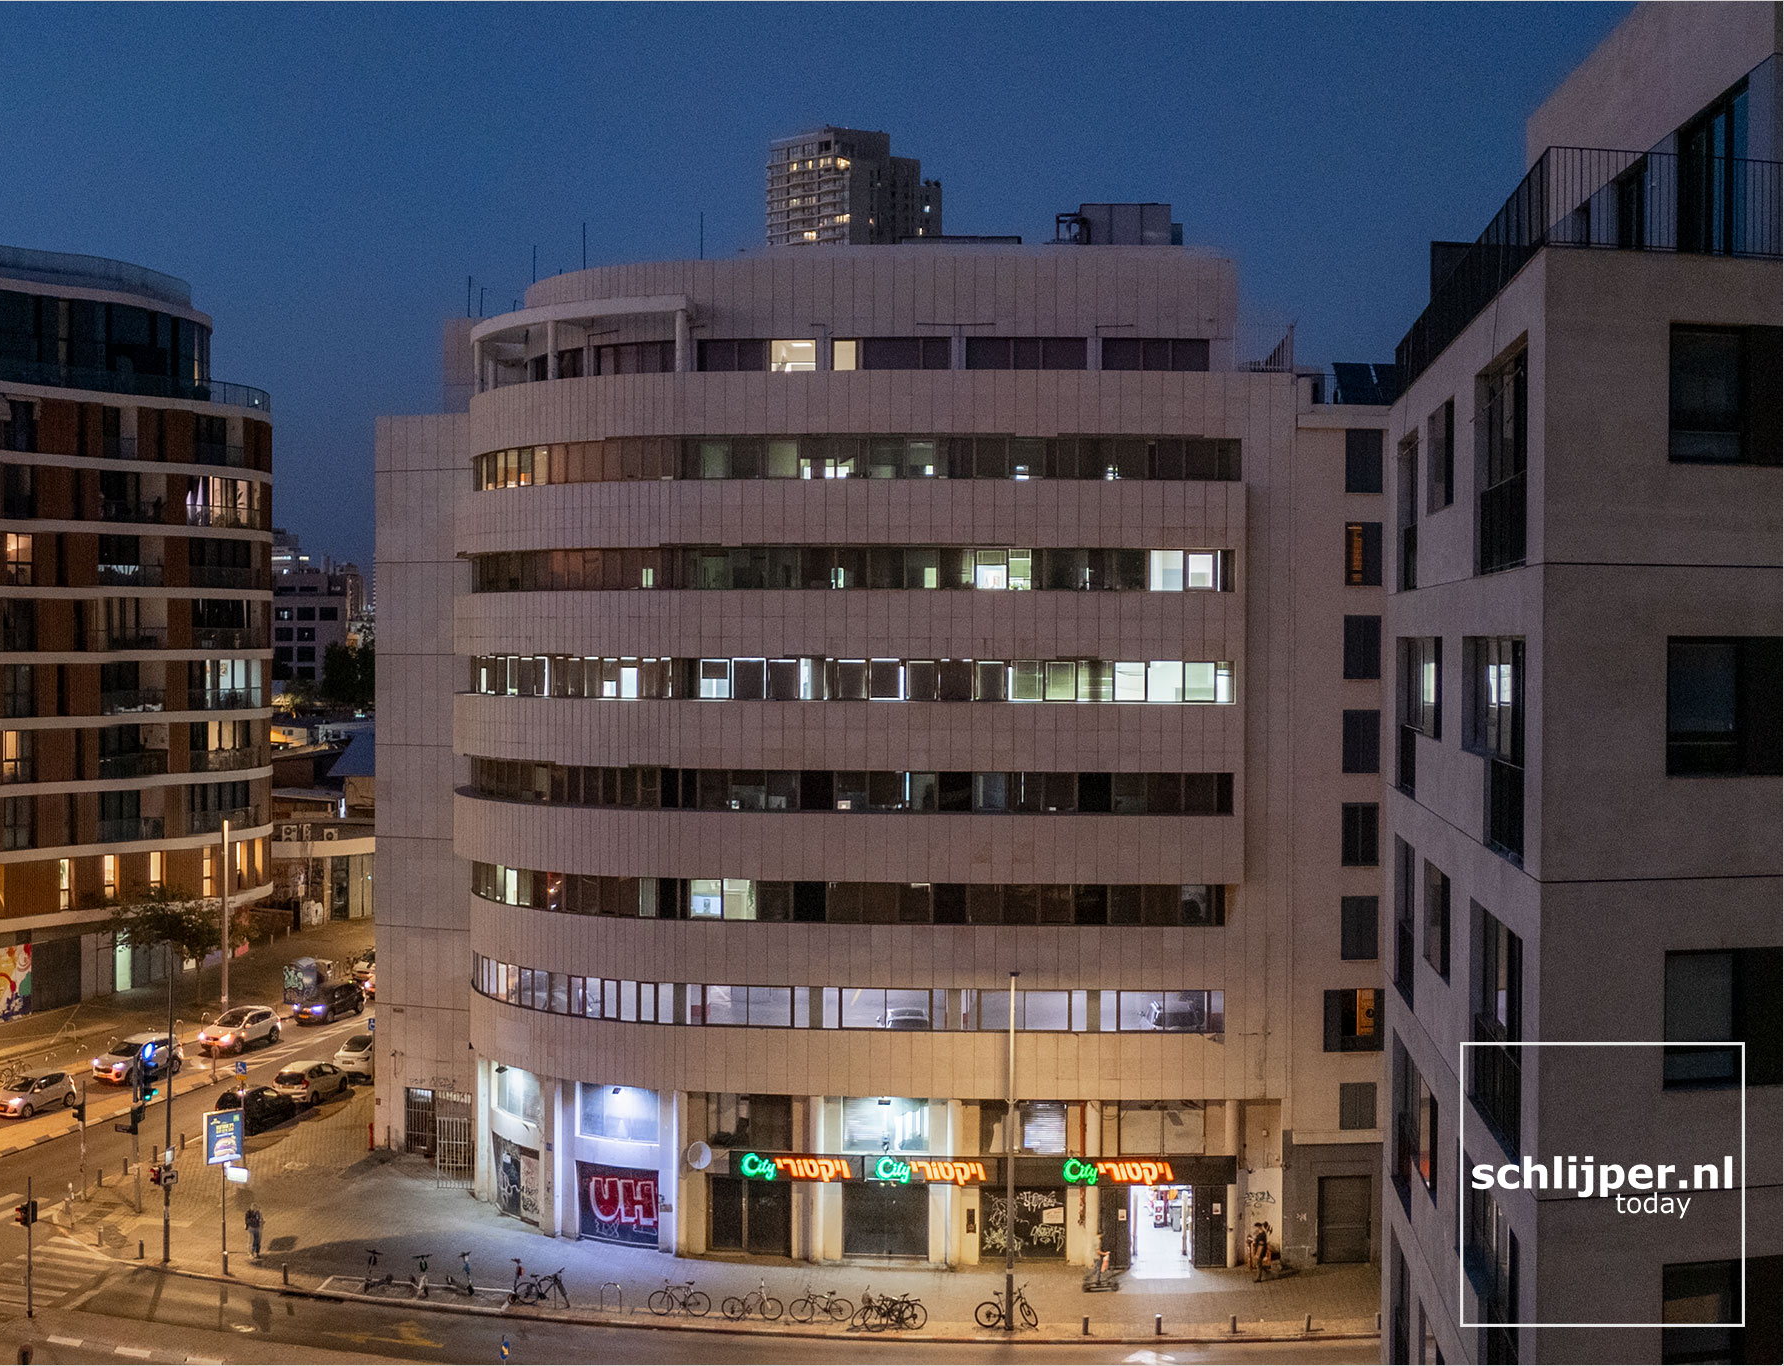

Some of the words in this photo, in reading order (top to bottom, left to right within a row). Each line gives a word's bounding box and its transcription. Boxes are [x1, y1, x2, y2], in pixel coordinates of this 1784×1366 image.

[741, 1153, 776, 1181] City
[774, 1157, 851, 1183] ויקטורי
[876, 1156, 911, 1184] City
[910, 1160, 987, 1186] ויקטורי
[1063, 1158, 1098, 1185] City
[1097, 1161, 1175, 1186] ויקטורי
